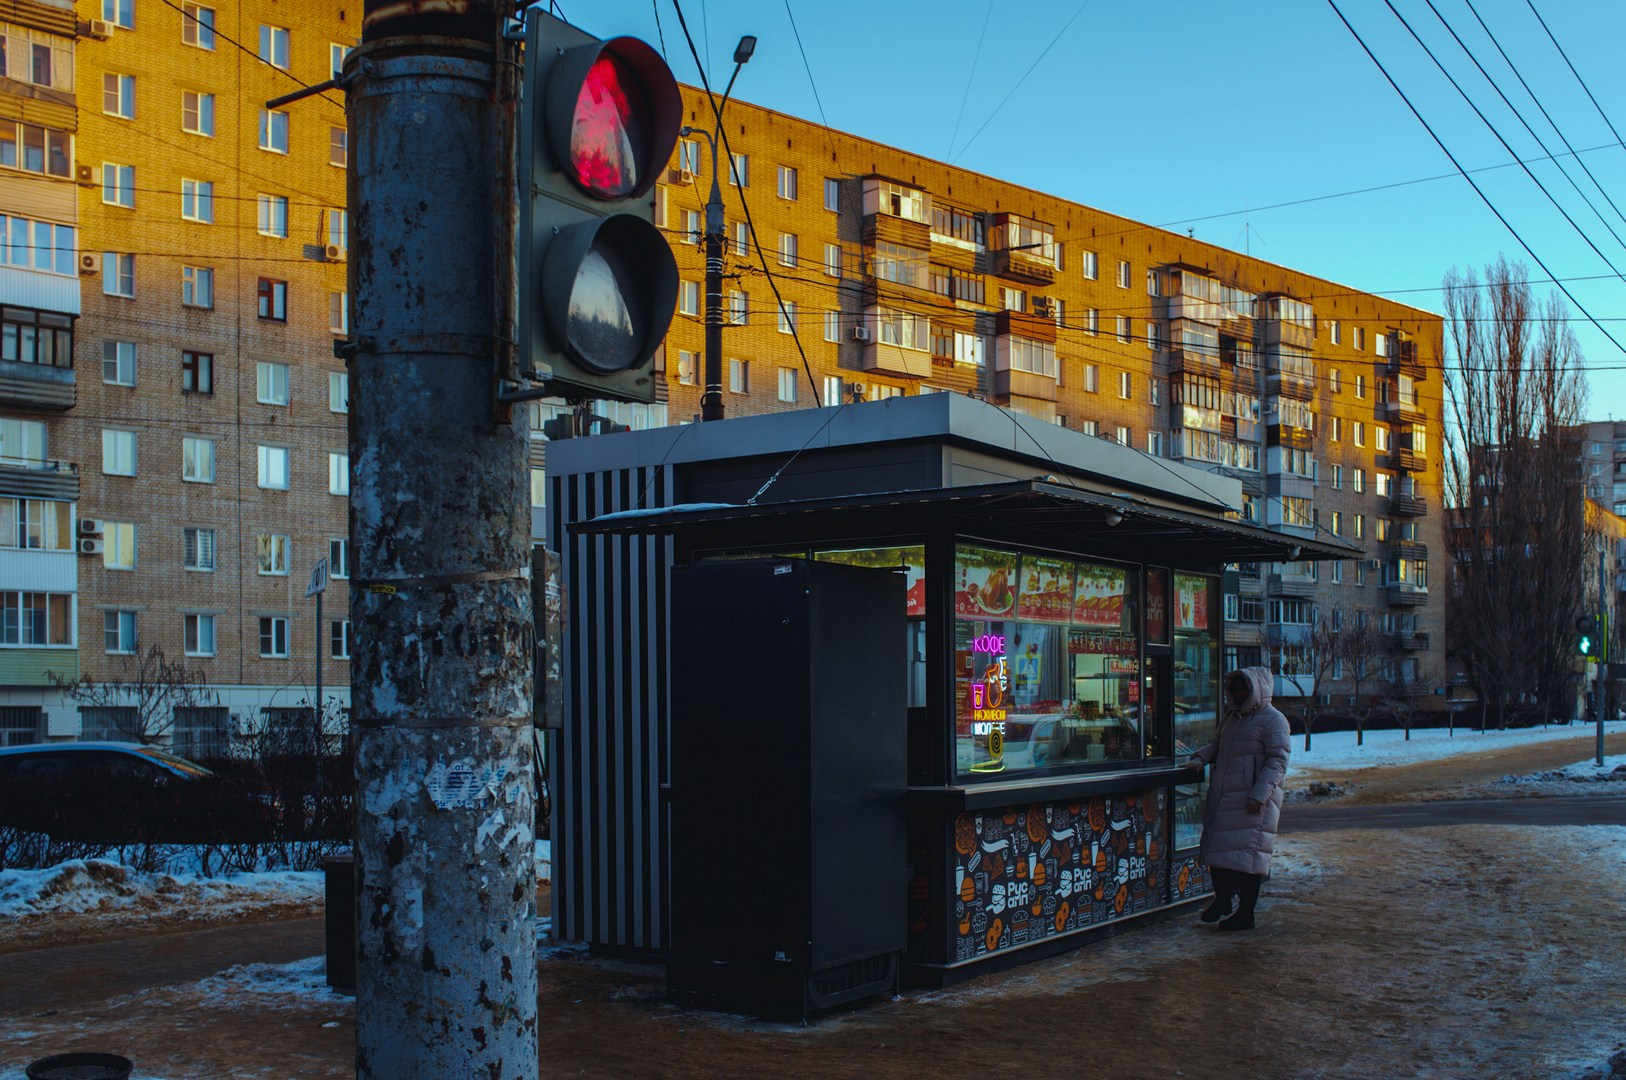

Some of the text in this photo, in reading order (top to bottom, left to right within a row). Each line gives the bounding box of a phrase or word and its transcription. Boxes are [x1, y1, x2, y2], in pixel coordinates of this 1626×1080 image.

[973, 635, 1005, 656] КОФЕ
[974, 722, 1006, 736] МОЛЕ
[1129, 856, 1146, 872] Рус
[1073, 867, 1092, 884] Рус
[1007, 881, 1028, 899] Рус
